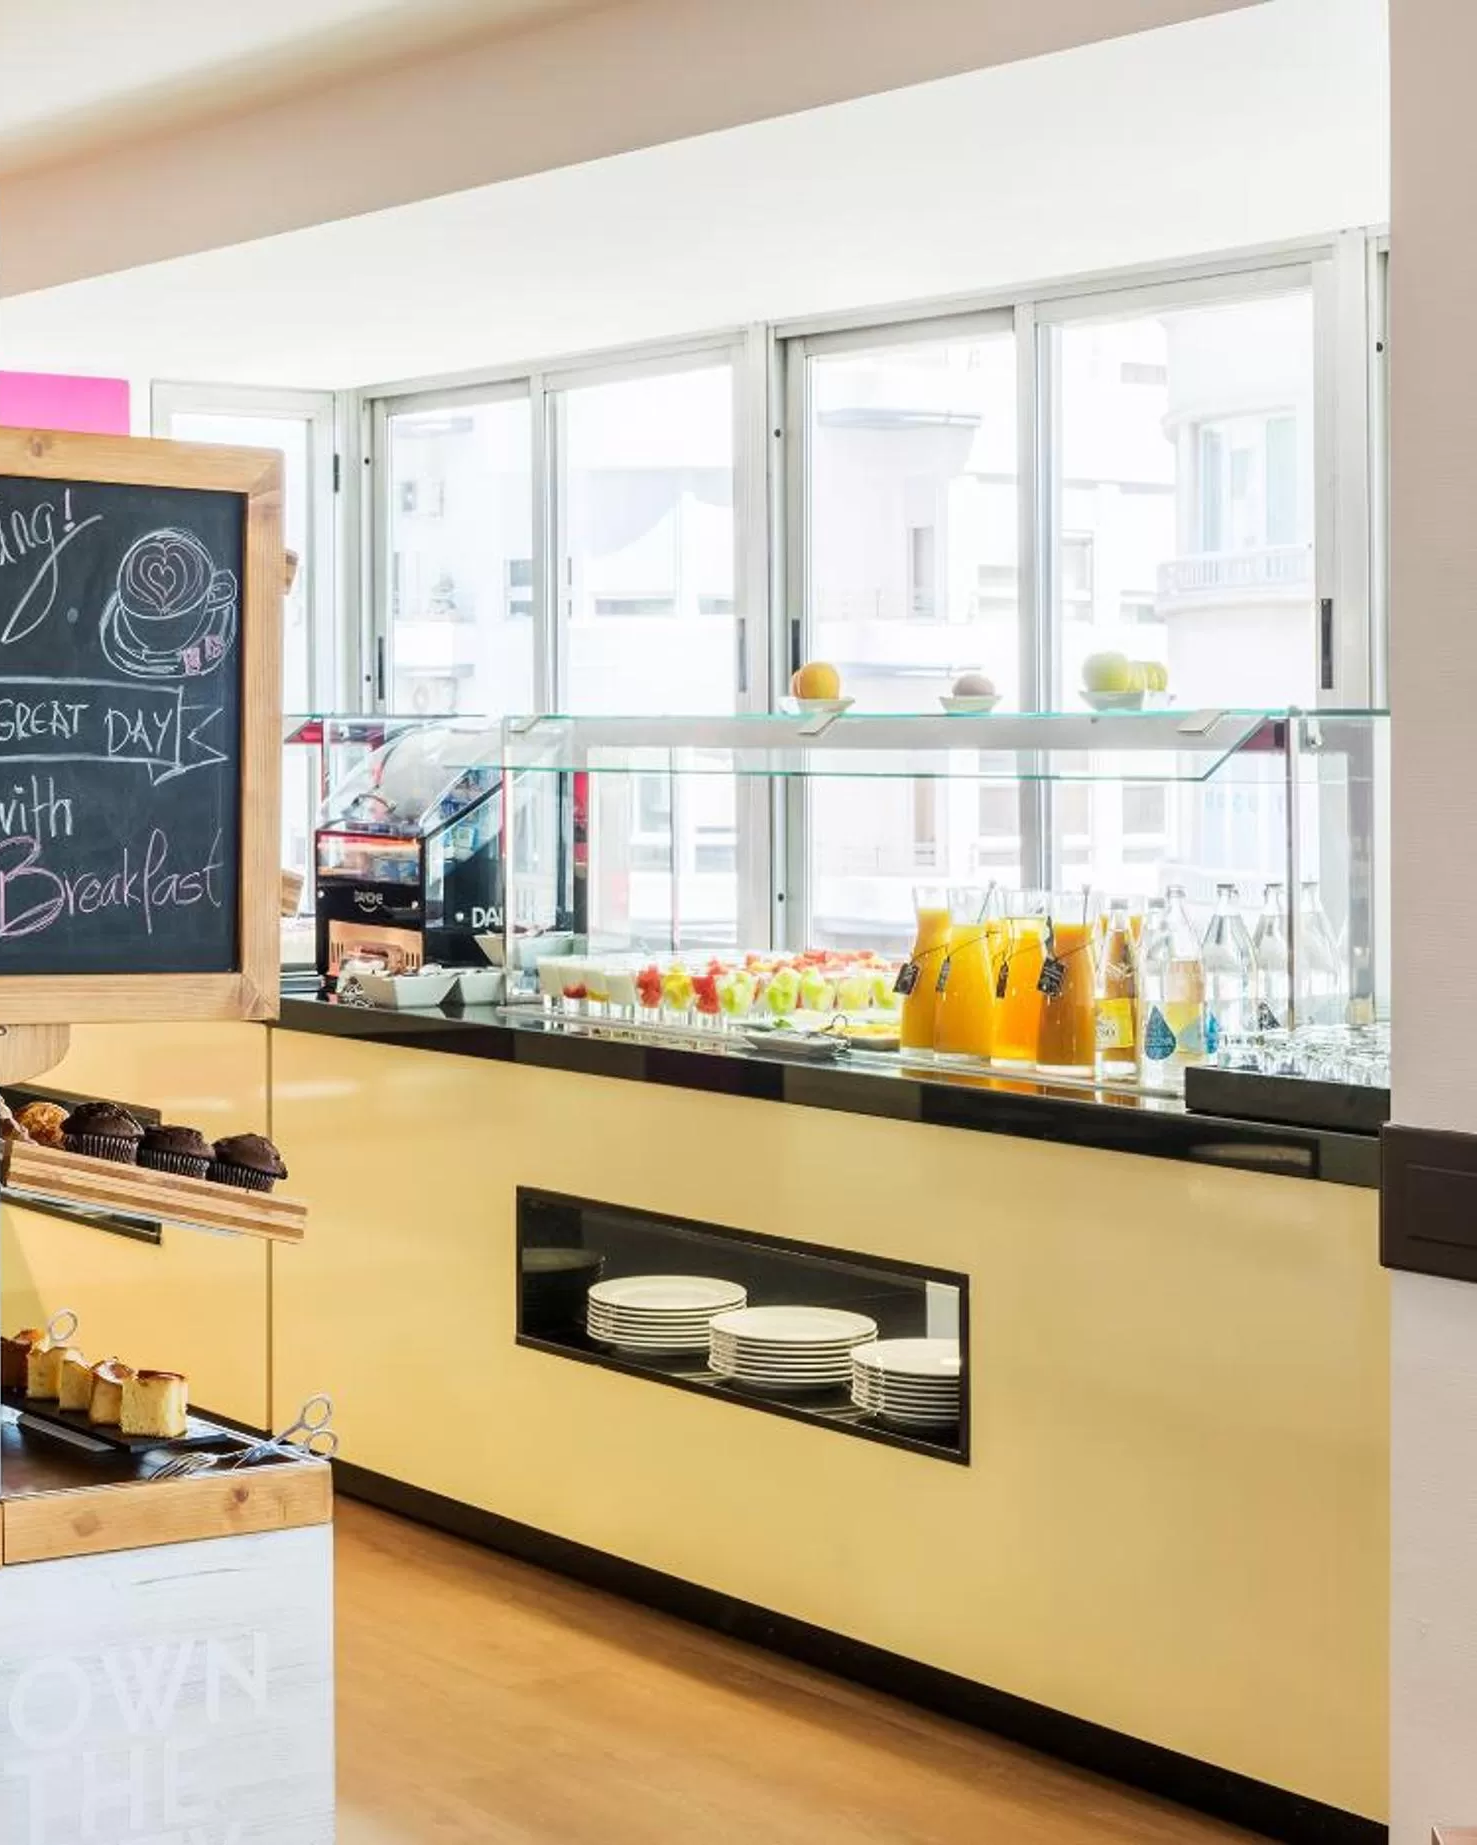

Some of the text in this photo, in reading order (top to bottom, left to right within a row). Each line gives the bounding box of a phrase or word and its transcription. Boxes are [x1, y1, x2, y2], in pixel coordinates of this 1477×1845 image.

[104, 707, 173, 758] DAY
[8, 1631, 268, 1750] OWN
[3, 1734, 210, 1845] THE
